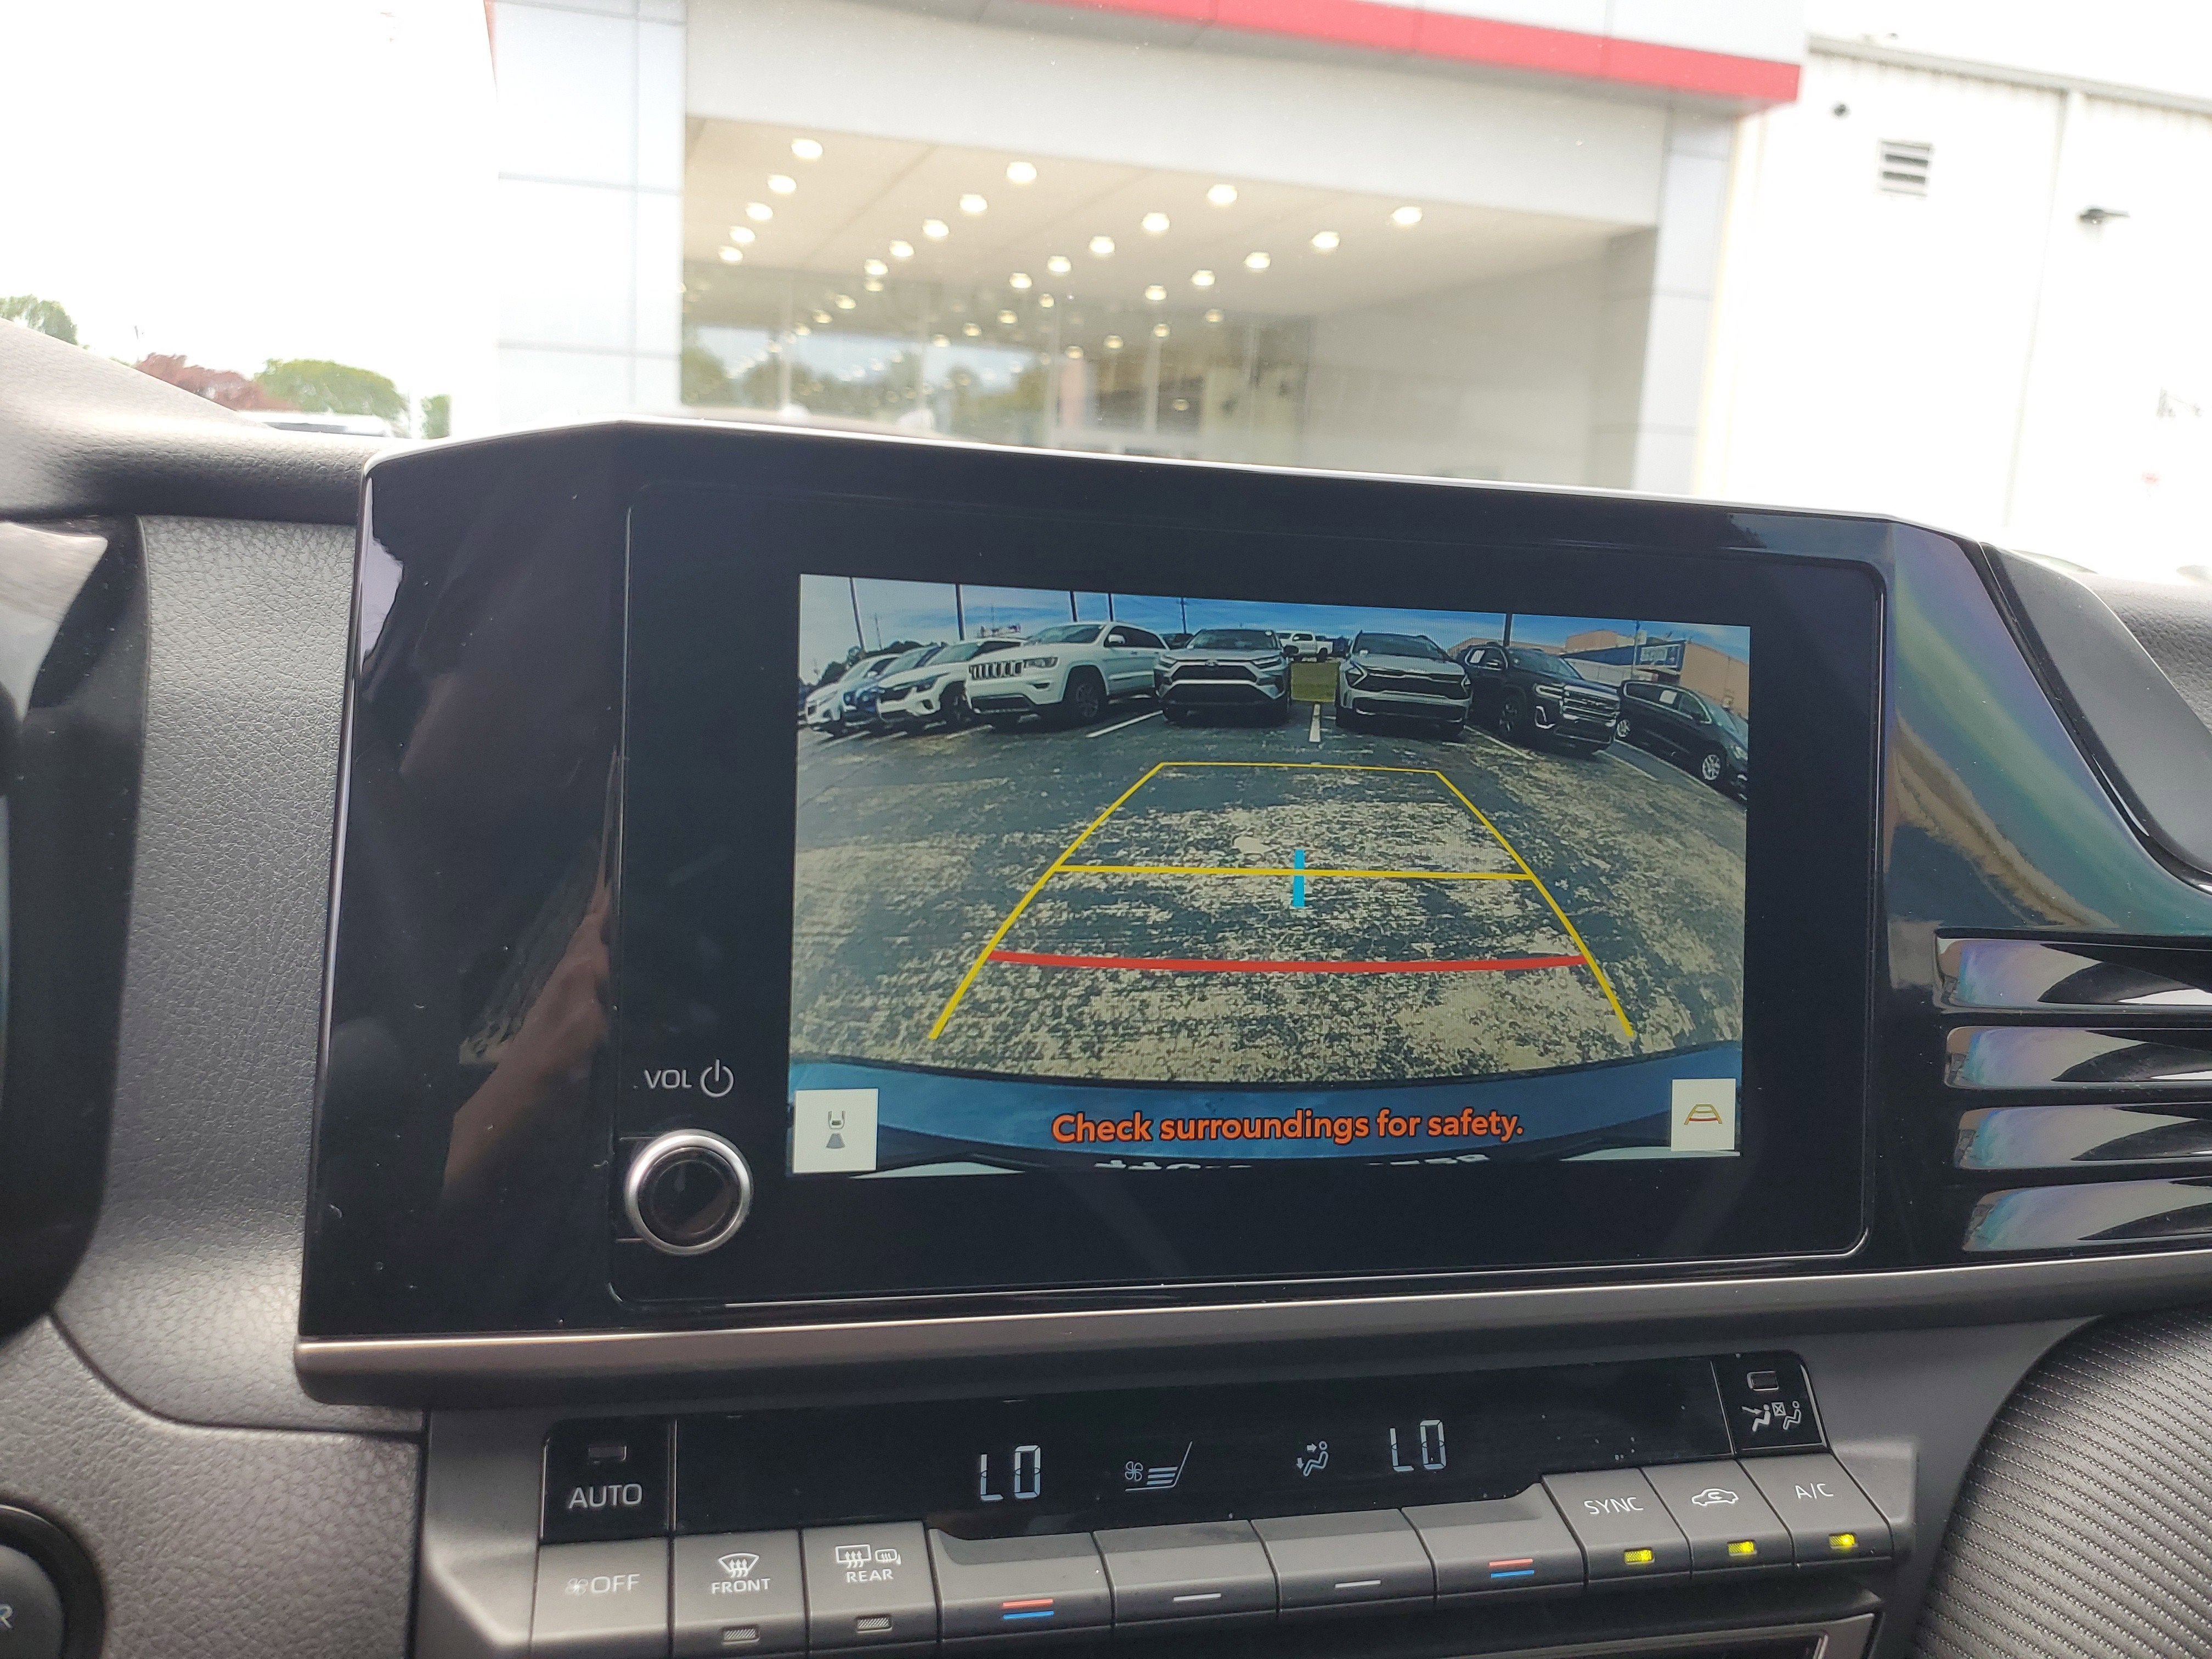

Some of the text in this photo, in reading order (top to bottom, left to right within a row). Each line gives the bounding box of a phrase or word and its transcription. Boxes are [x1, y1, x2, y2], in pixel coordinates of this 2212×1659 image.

[644, 1069, 692, 1090] VOL
[1052, 1108, 1524, 1145] Check surroundings for safety.
[568, 1483, 643, 1510] AUTO
[1795, 1482, 1835, 1500] A/C
[1583, 1496, 1644, 1515] SYNC
[590, 1573, 641, 1594] OFF
[845, 1567, 894, 1583] REAR
[710, 1577, 771, 1595] FRONT
